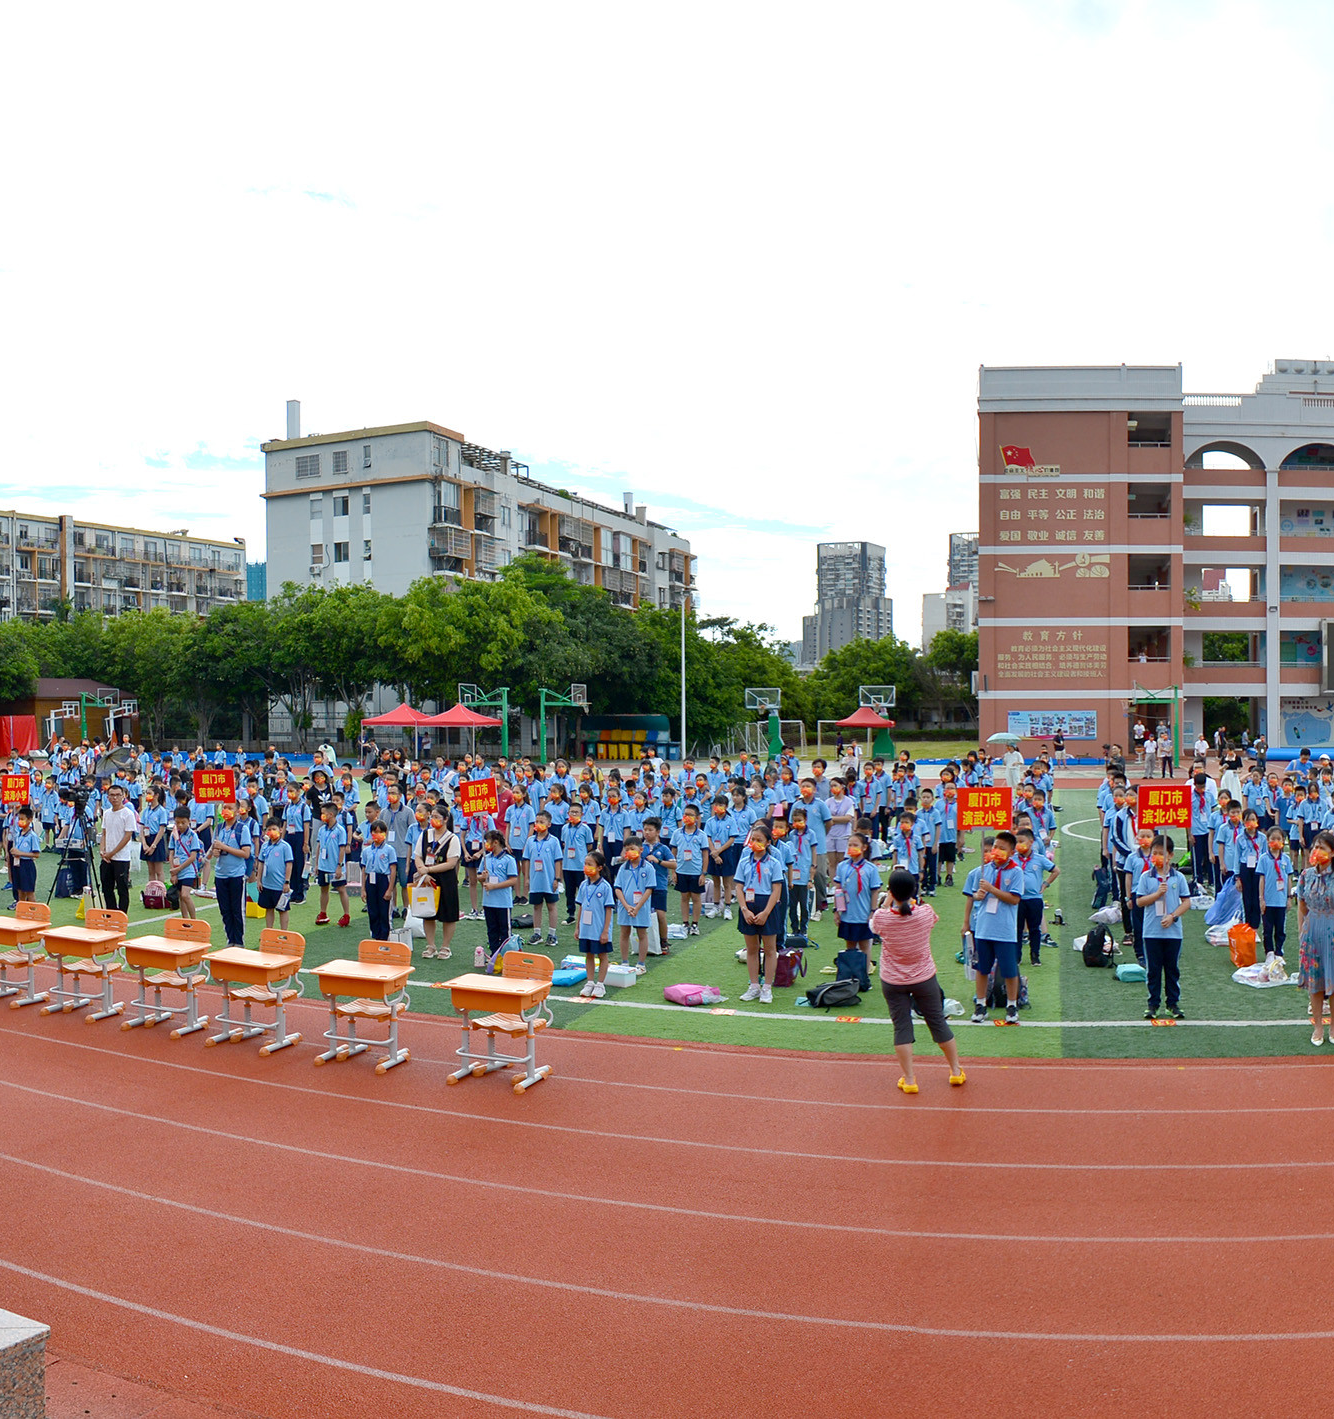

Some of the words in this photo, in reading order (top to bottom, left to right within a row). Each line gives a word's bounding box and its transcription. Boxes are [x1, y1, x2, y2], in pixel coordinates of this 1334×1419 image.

[999, 488, 1021, 500] 富强
[1027, 488, 1049, 500] 民主
[1055, 488, 1077, 500] 文明
[1083, 488, 1105, 500] 和谐
[999, 510, 1021, 520] 自由
[1027, 510, 1049, 520] 平等
[1055, 510, 1077, 520] 公正
[1083, 510, 1105, 520] 法治
[999, 530, 1021, 541] 爱国
[1027, 530, 1049, 541] 敬业
[1055, 530, 1077, 541] 诚信
[1083, 530, 1105, 541] 友善
[1022, 630, 1084, 641] 教育方针
[7, 778, 25, 788] 厦门市
[201, 774, 225, 784] 厦门市
[468, 783, 489, 798] 厦门市
[463, 797, 497, 812] 会展南小学
[968, 792, 1002, 808] 厦门市
[1148, 790, 1183, 806] 厦门市
[963, 810, 1007, 826] 演武小学
[1142, 808, 1188, 824] 滨北小学
